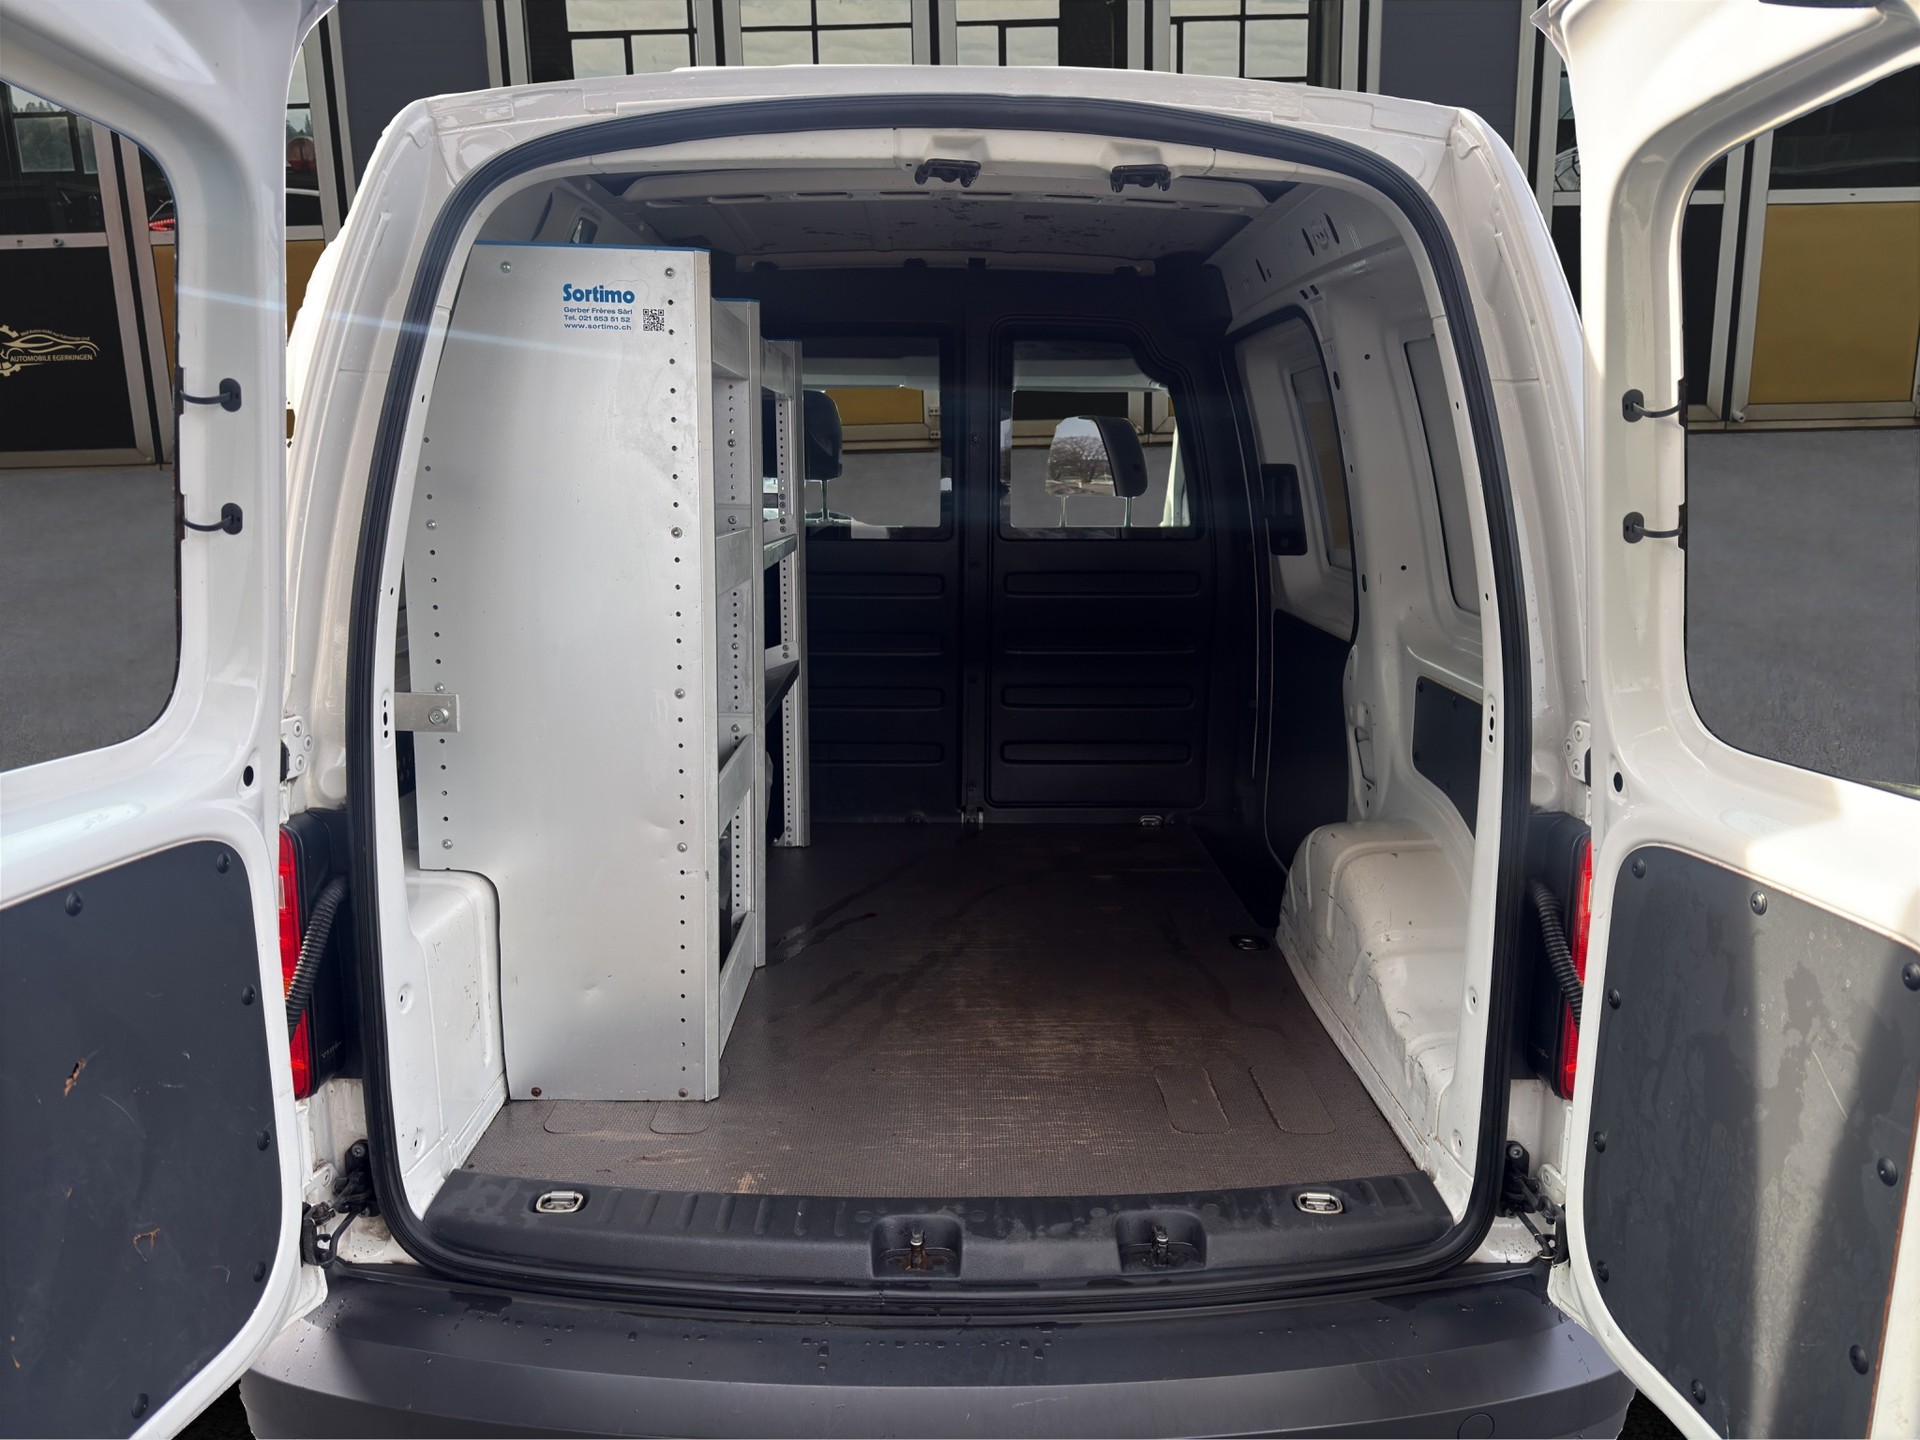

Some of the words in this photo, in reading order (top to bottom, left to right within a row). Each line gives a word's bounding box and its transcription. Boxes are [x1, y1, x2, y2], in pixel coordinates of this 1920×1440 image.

[563, 283, 635, 304] Sortimo
[563, 306, 590, 314] Gerber
[564, 323, 632, 331] www.sortimo.ch
